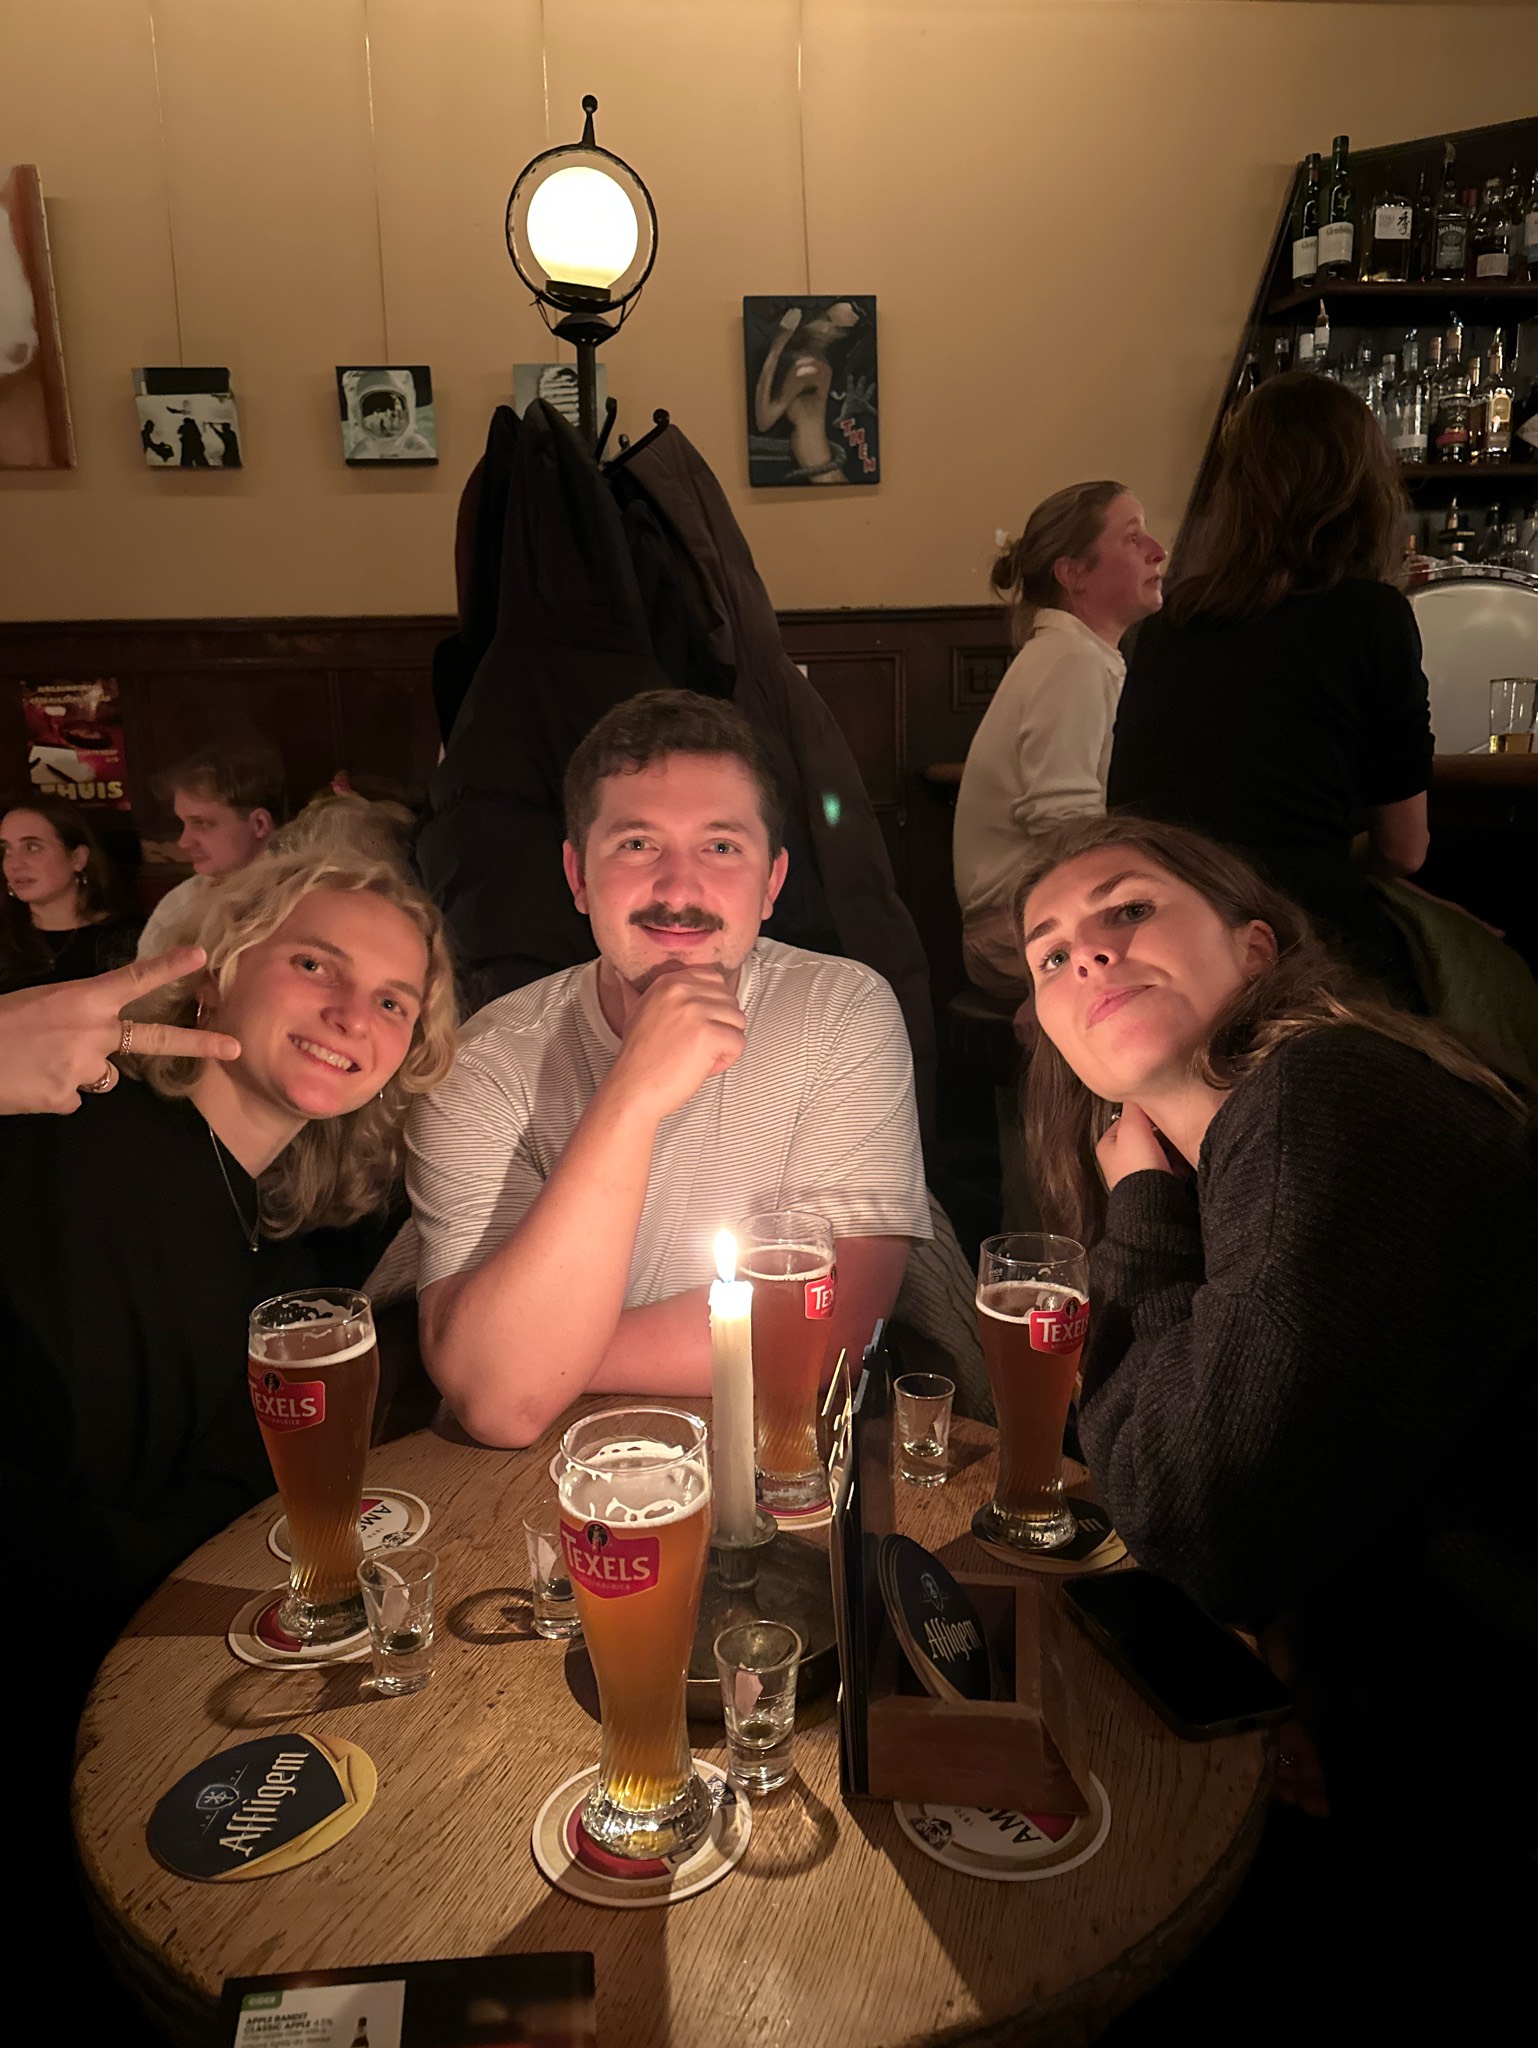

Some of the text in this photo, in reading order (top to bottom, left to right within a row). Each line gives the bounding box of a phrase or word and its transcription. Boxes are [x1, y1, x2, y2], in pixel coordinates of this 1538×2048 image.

[840, 417, 876, 473] THEN
[562, 1530, 651, 1581] TEXELS
[923, 1617, 983, 1664] Affligem
[219, 1751, 310, 1858] Affligem
